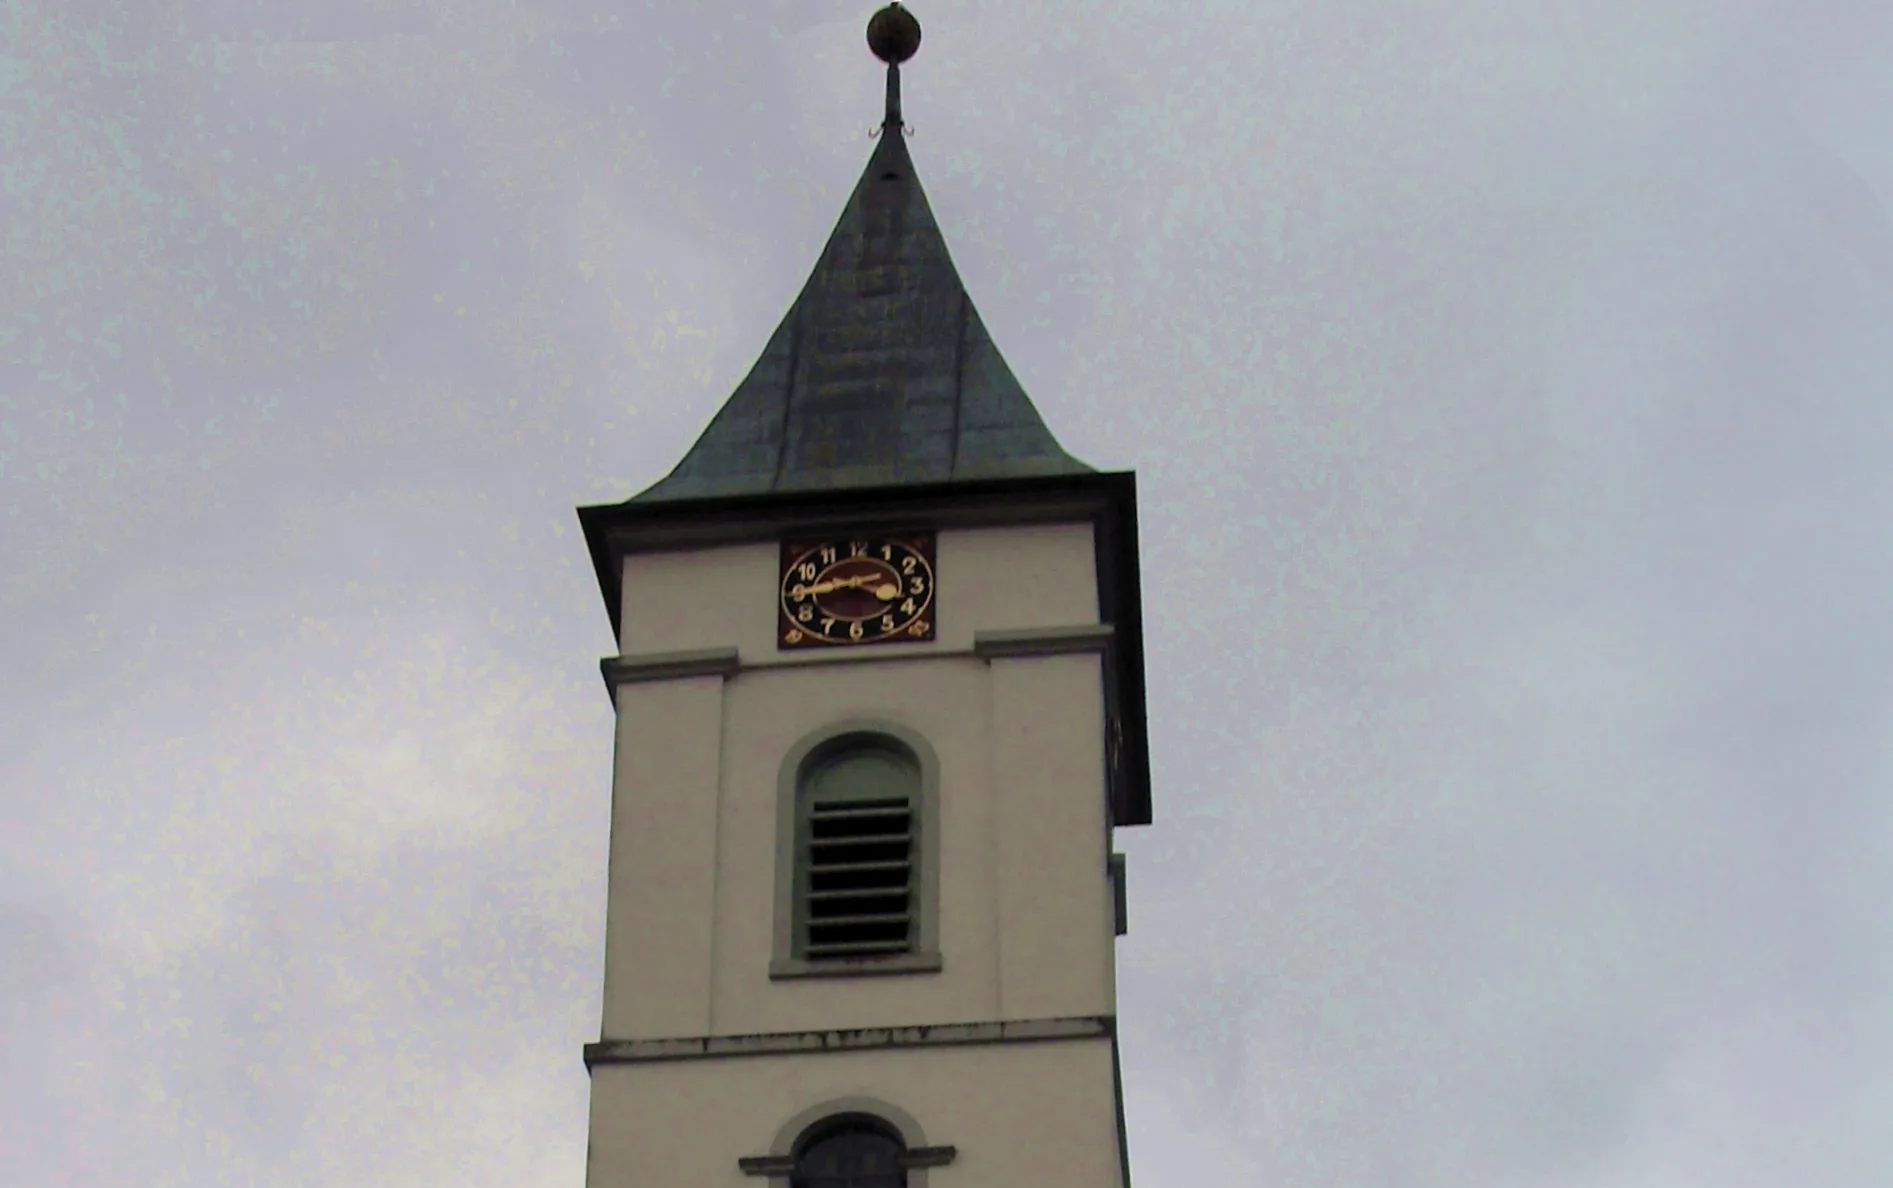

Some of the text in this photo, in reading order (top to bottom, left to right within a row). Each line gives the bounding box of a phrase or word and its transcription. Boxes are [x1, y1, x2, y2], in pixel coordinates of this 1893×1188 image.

[821, 548, 836, 564] 11
[882, 545, 892, 561] 1
[799, 563, 816, 581] 10
[902, 556, 917, 575] 2
[910, 576, 925, 595] 3
[799, 604, 813, 622] 8
[900, 598, 916, 615] 4
[820, 617, 835, 635] 7
[850, 620, 863, 640] 6
[881, 614, 895, 632] 5
